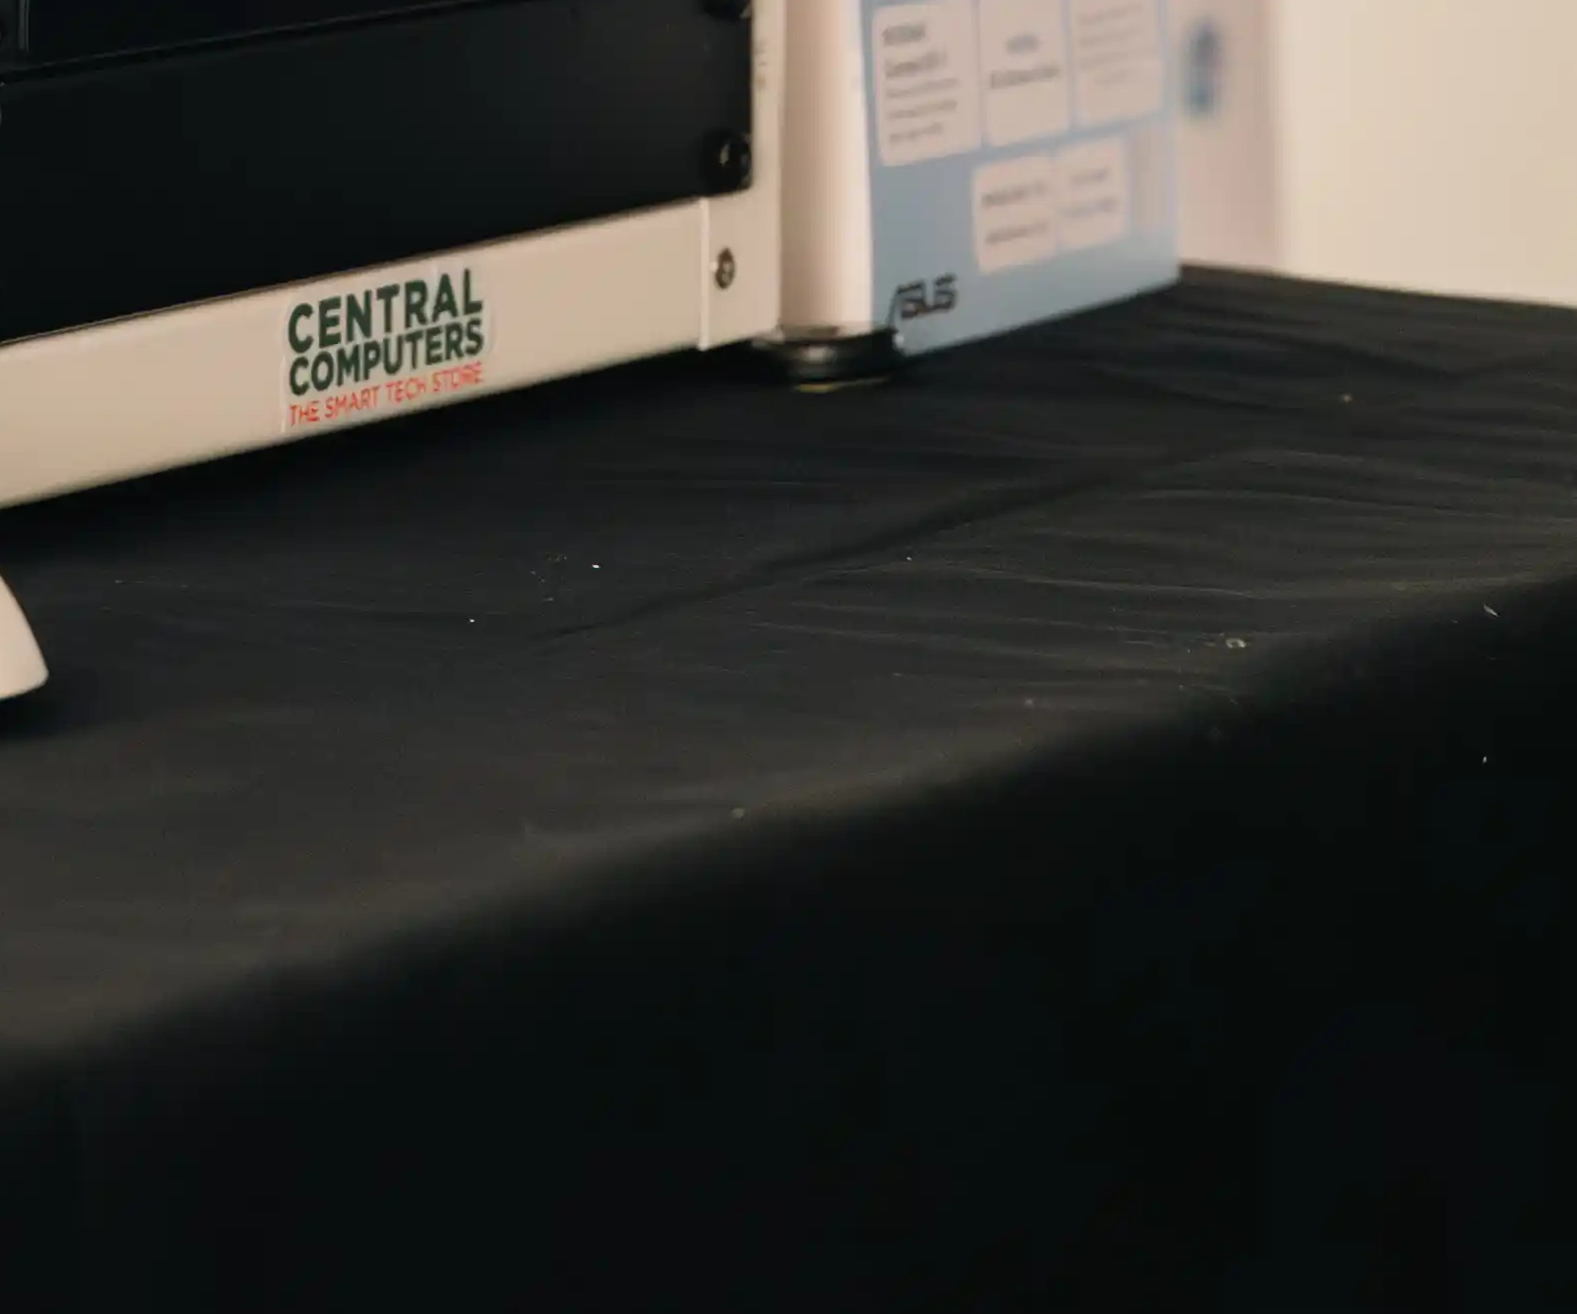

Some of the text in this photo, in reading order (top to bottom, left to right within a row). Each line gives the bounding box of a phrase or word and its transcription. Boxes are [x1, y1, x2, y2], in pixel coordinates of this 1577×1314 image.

[288, 268, 483, 354] CENTRAL
[289, 318, 484, 397] COMPUTERS
[289, 361, 483, 426] THE SMART TECH STORE
